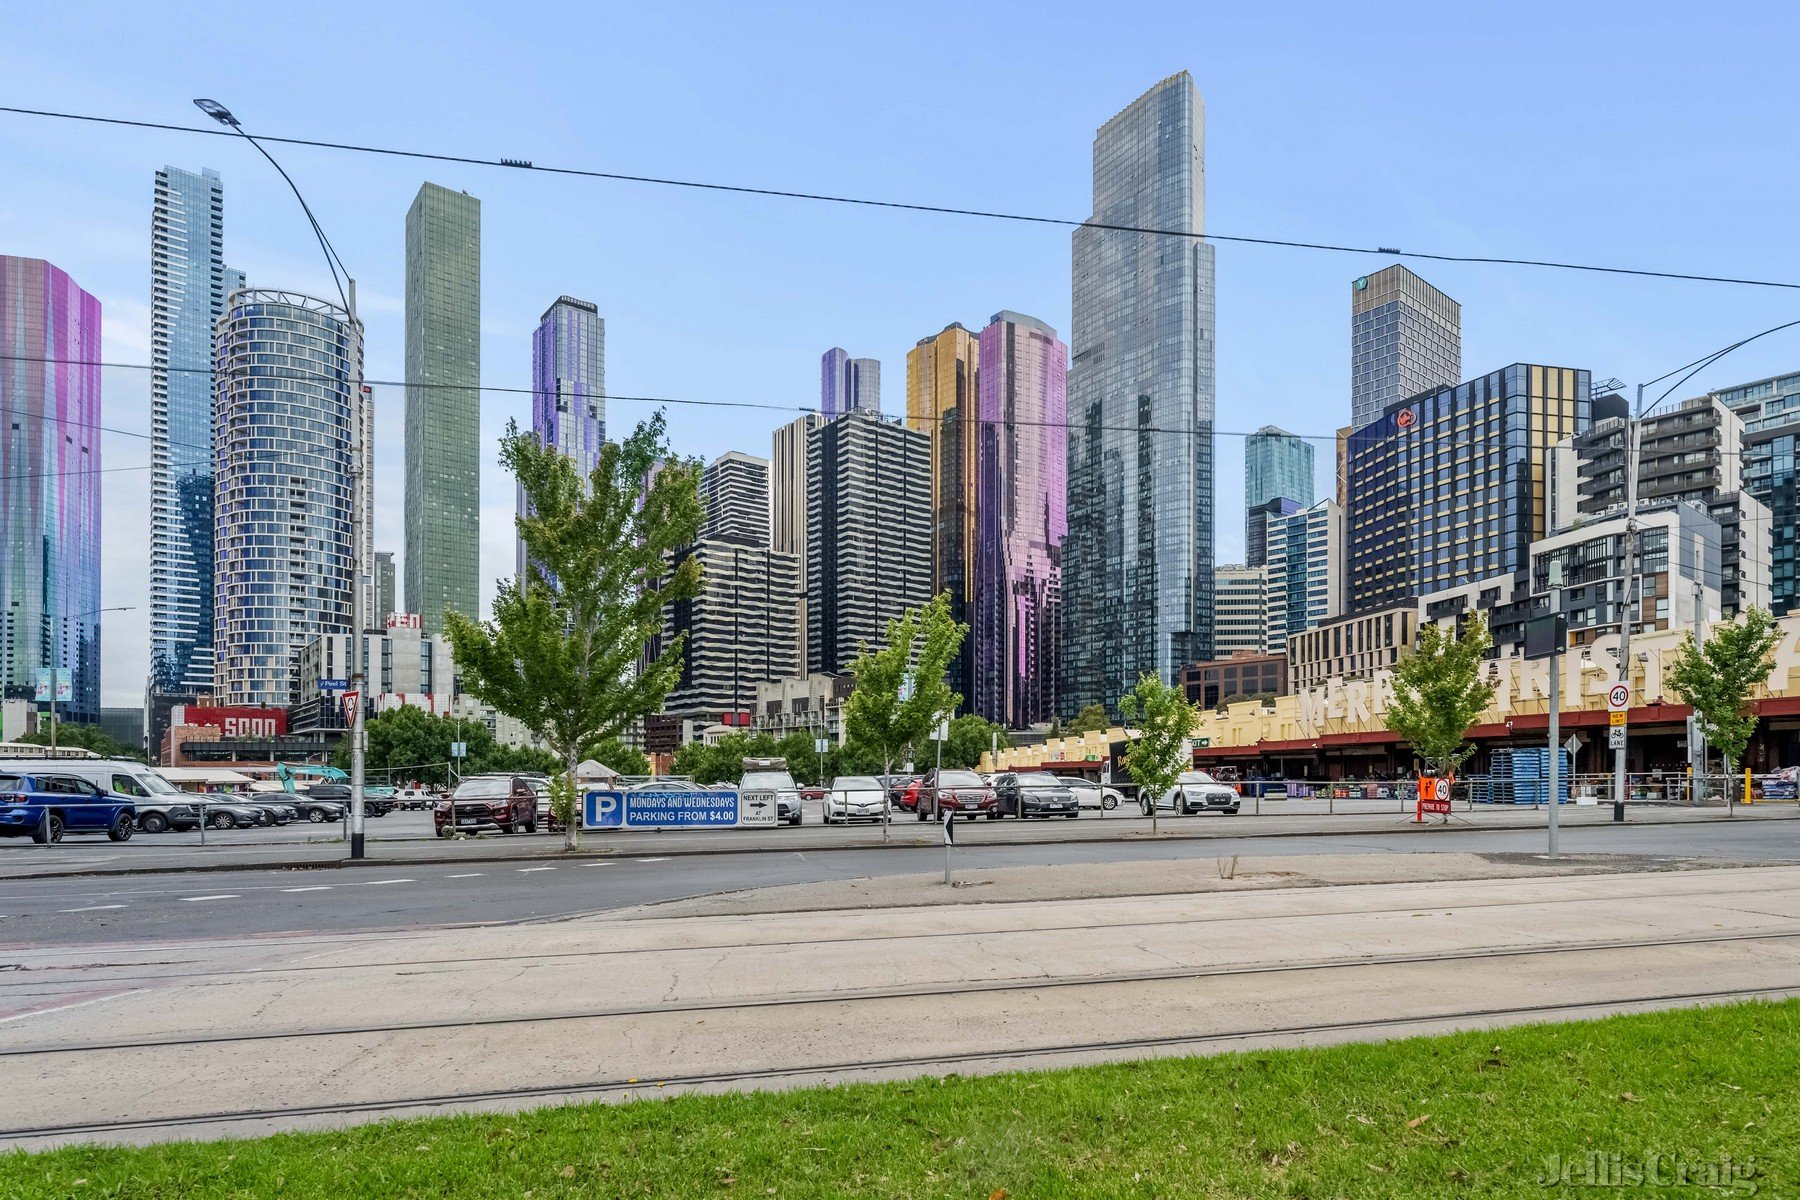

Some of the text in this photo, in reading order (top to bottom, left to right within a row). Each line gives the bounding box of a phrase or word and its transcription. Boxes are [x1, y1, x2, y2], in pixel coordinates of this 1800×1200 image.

[1298, 668, 1423, 728] MERR
[1613, 691, 1626, 701] 40
[224, 718, 276, 738] SOON
[1438, 784, 1447, 794] 40
[630, 797, 734, 808] MONDAYS AND WEDNESDAYS
[596, 796, 617, 822] P
[630, 811, 734, 821] PARKING FROM $4.00
